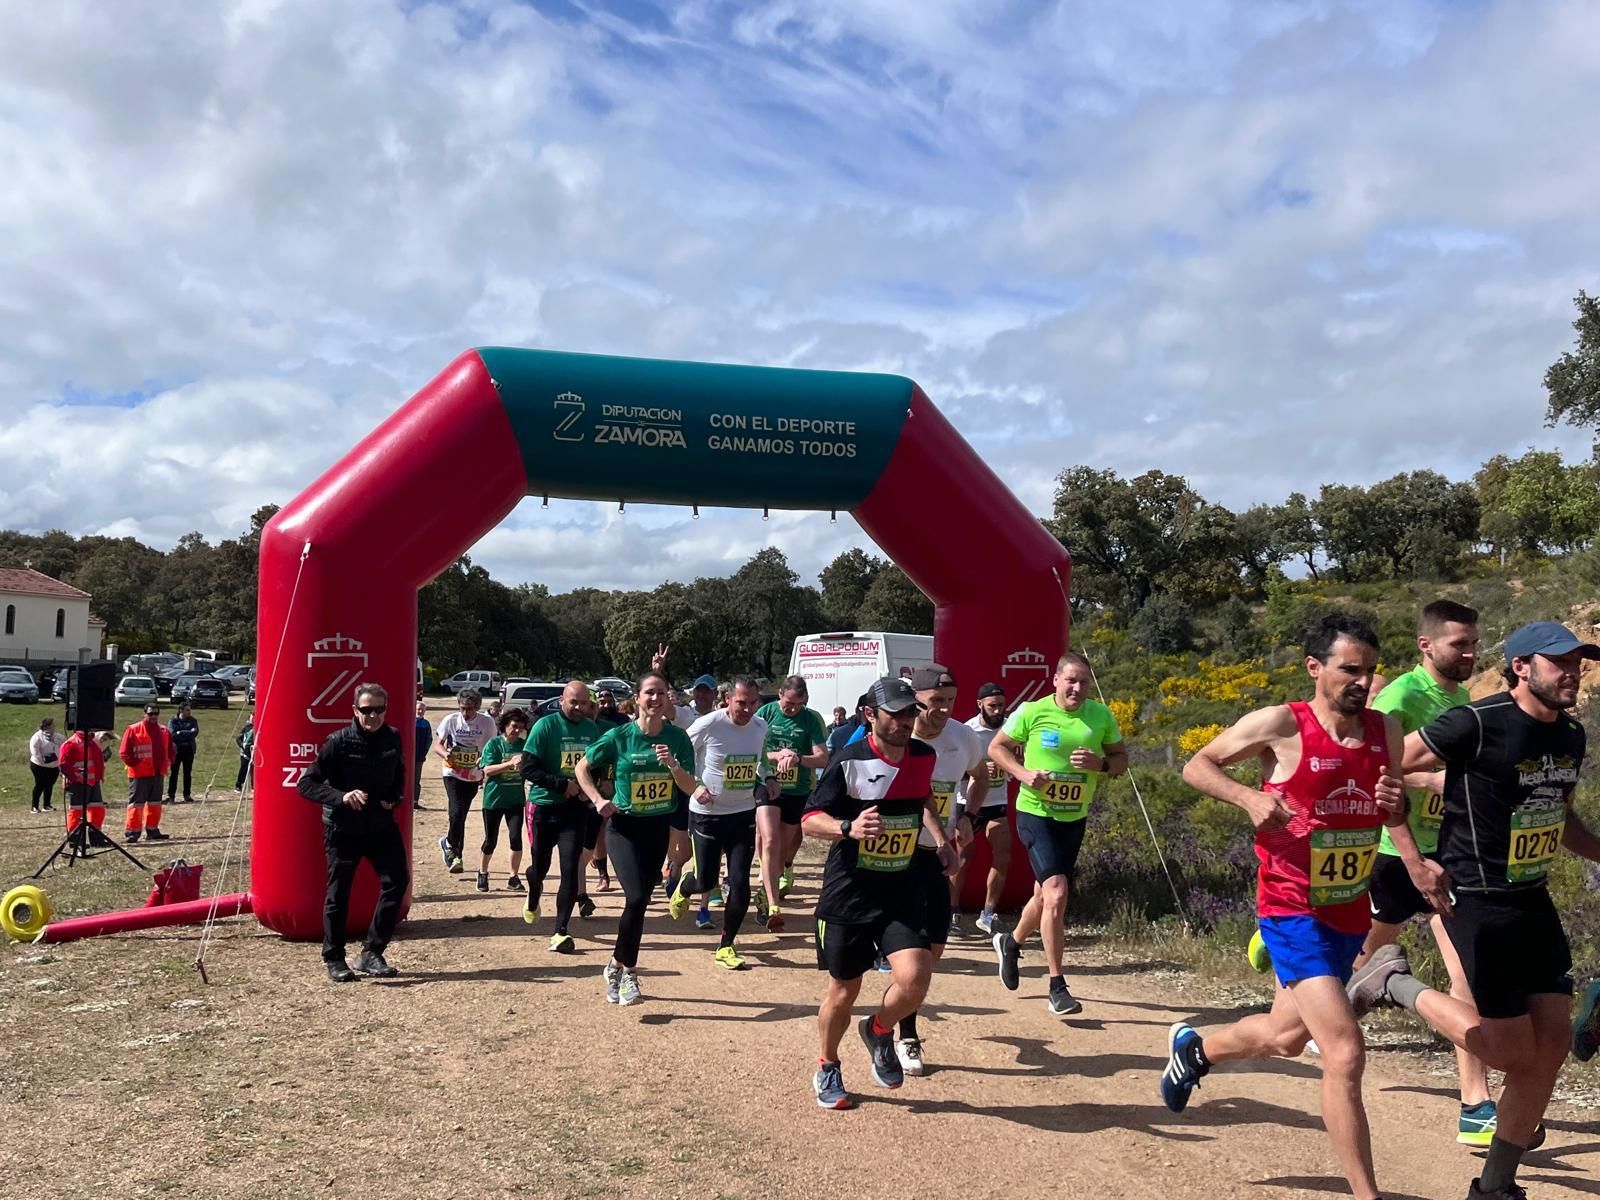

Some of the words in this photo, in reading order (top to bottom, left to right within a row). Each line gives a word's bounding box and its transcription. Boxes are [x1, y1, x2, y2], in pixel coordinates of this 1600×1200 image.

[710, 413, 747, 429] CON
[752, 416, 773, 430] EL
[778, 418, 856, 435] DEPORTE
[594, 425, 687, 448] ZAMORA
[708, 435, 794, 454] GANAMOS
[800, 441, 857, 458] TODOS
[799, 641, 879, 653] GLOBALPODIUM
[726, 765, 753, 780] 0276
[636, 782, 667, 801] 482
[1046, 783, 1081, 801] 490
[864, 833, 912, 854] 0267
[1515, 828, 1559, 861] 0278
[1319, 849, 1374, 882] 487
